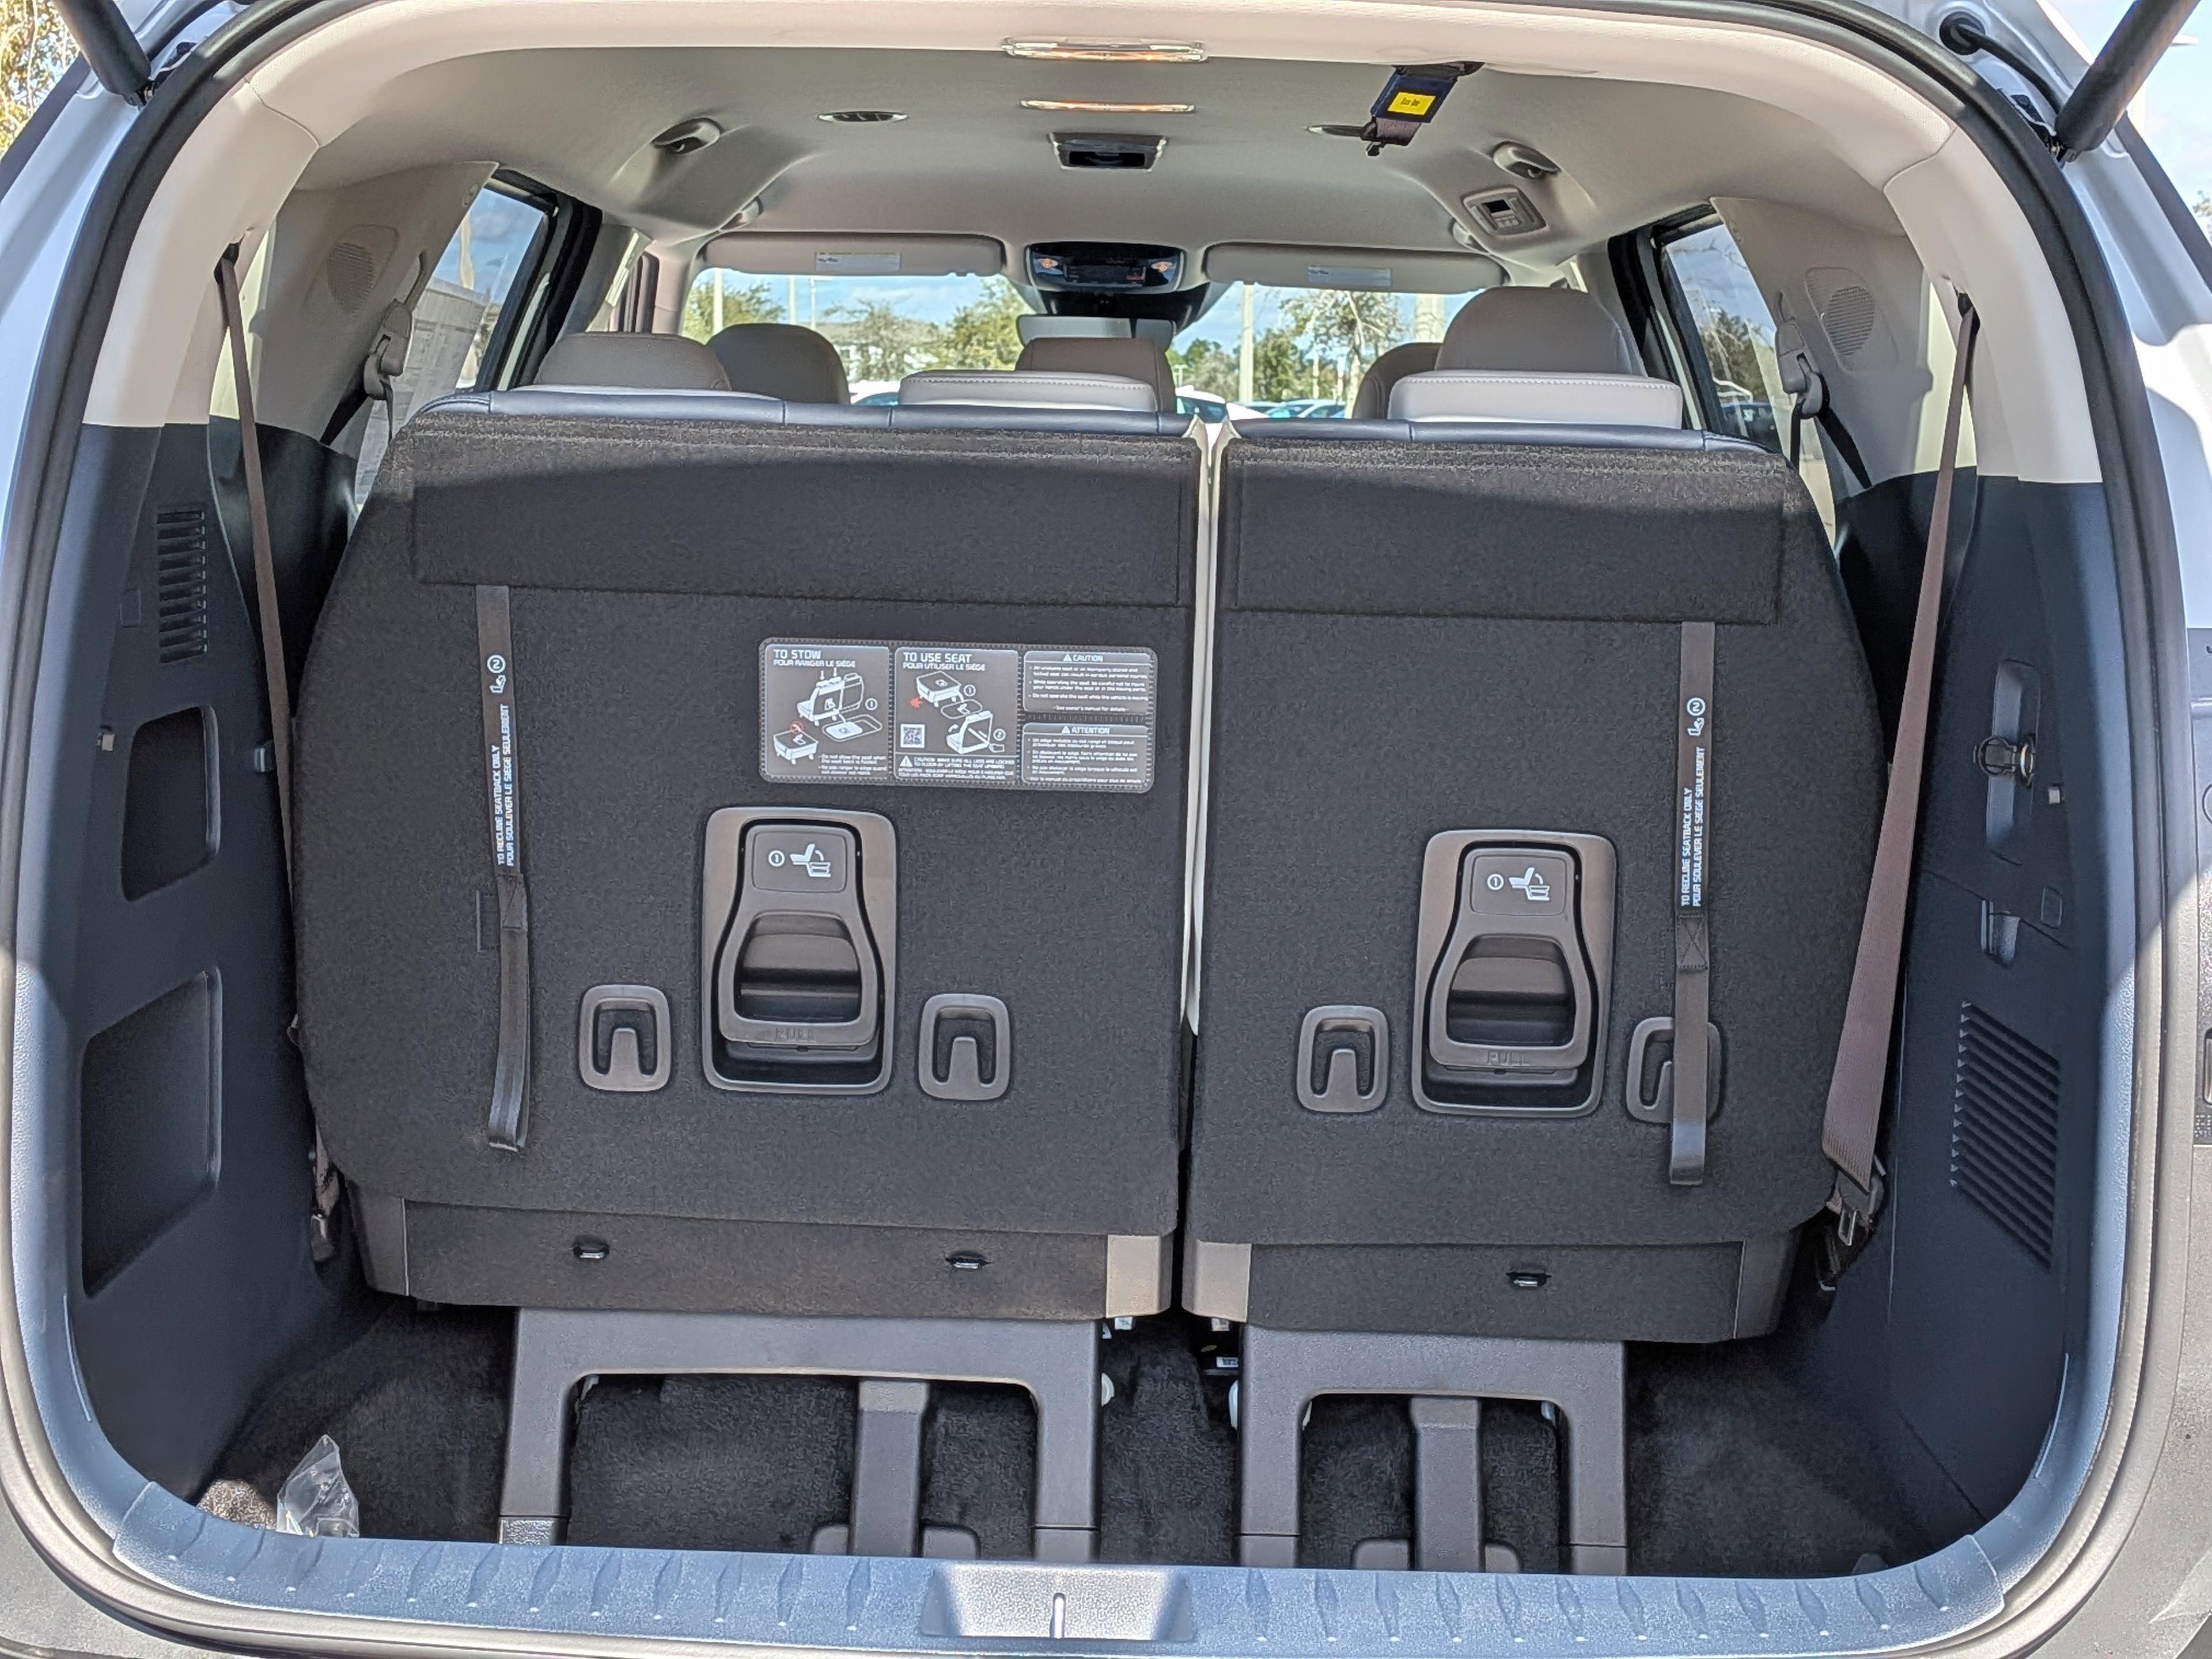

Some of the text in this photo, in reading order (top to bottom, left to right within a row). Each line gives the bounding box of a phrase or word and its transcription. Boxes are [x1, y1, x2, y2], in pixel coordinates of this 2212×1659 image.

[773, 649, 821, 659] TO STOW
[903, 652, 972, 663] TO USE SEAT
[1073, 654, 1104, 662] CAUTION
[493, 770, 503, 815] SEATBACK
[1681, 812, 1692, 857] SEATBACK
[1694, 826, 1703, 836] LE
[497, 854, 505, 865] TO
[506, 842, 514, 866] POUR
[1693, 838, 1703, 882] SOULEVER
[1681, 896, 1690, 907] TO
[1693, 884, 1702, 907] POUR
[774, 1027, 816, 1042] PULL
[1486, 1050, 1530, 1066] PULL
